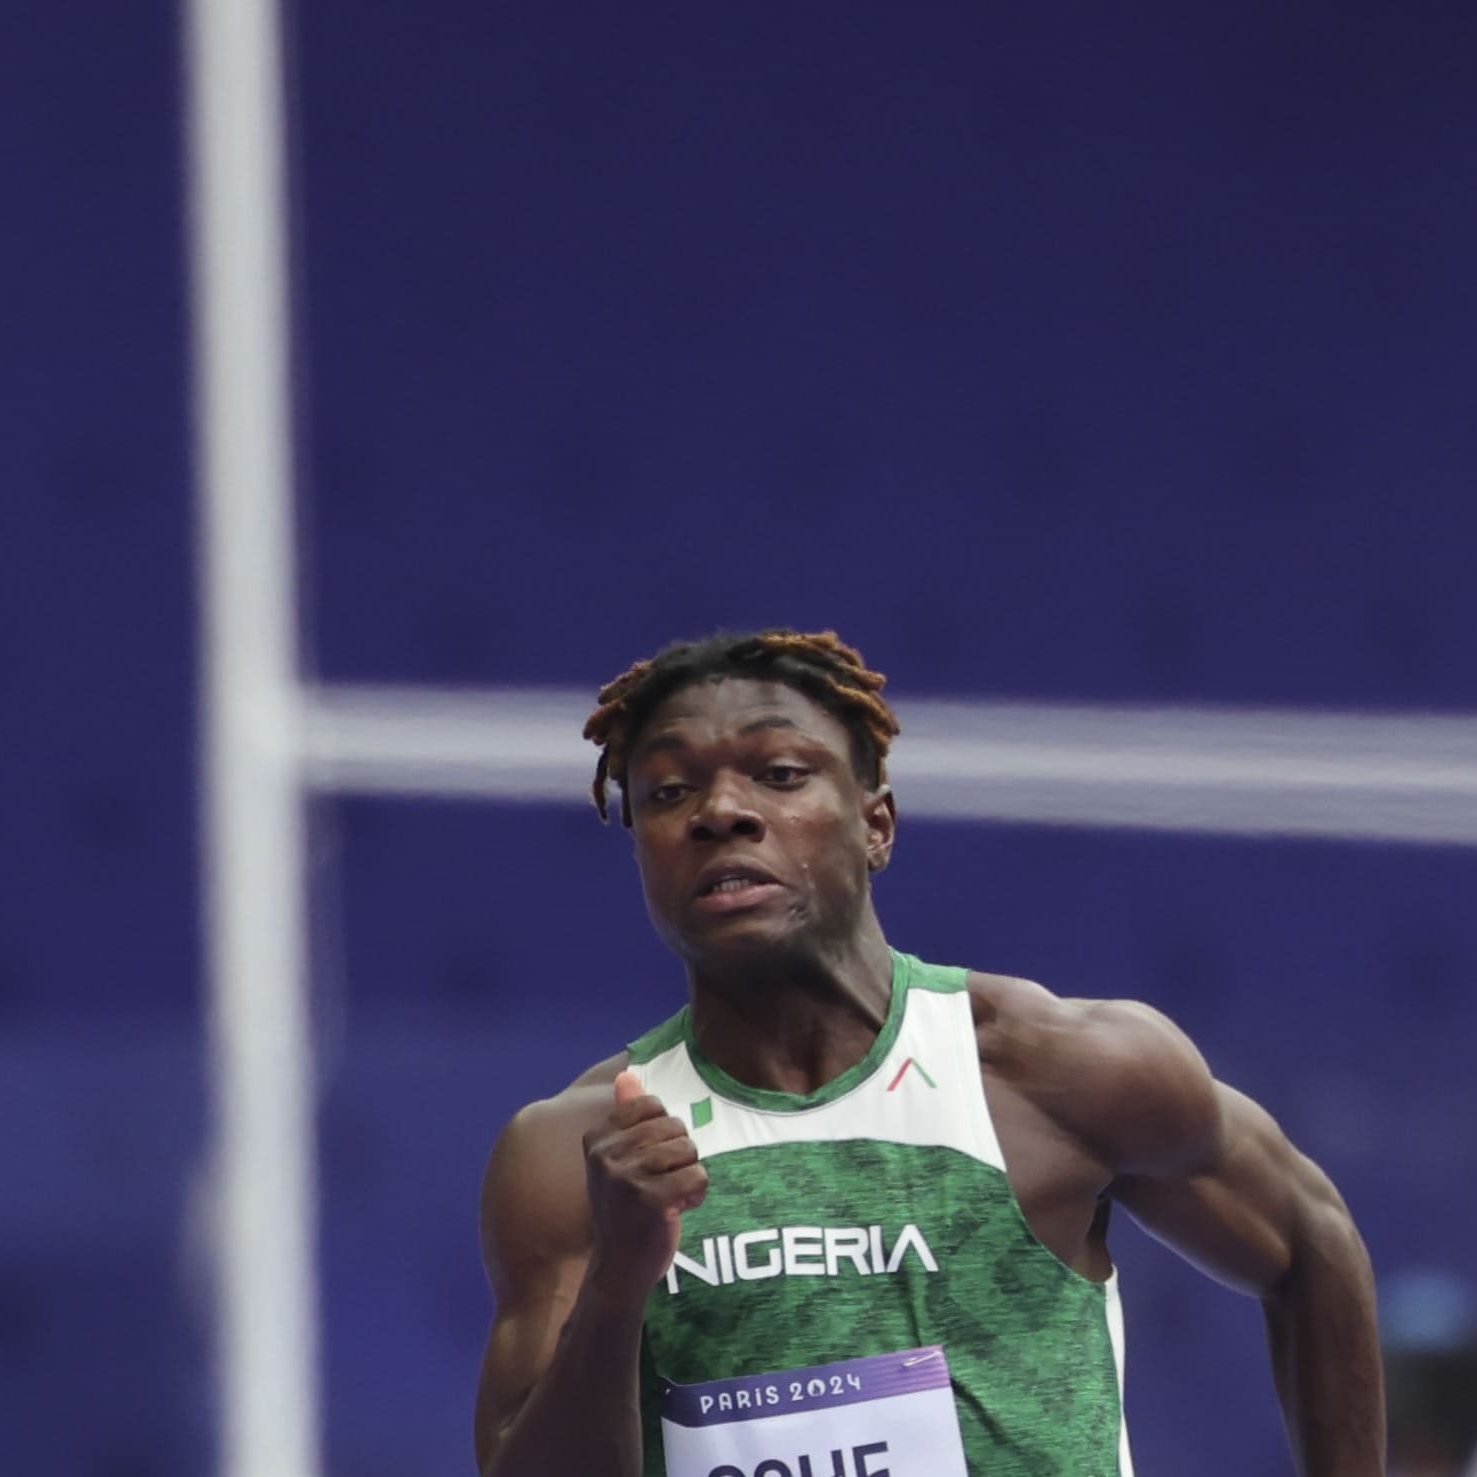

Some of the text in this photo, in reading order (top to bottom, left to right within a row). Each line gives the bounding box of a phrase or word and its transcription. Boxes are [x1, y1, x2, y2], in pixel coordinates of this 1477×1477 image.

[665, 1224, 939, 1295] NIGERIA
[700, 1373, 862, 1415] PARIS 2024
